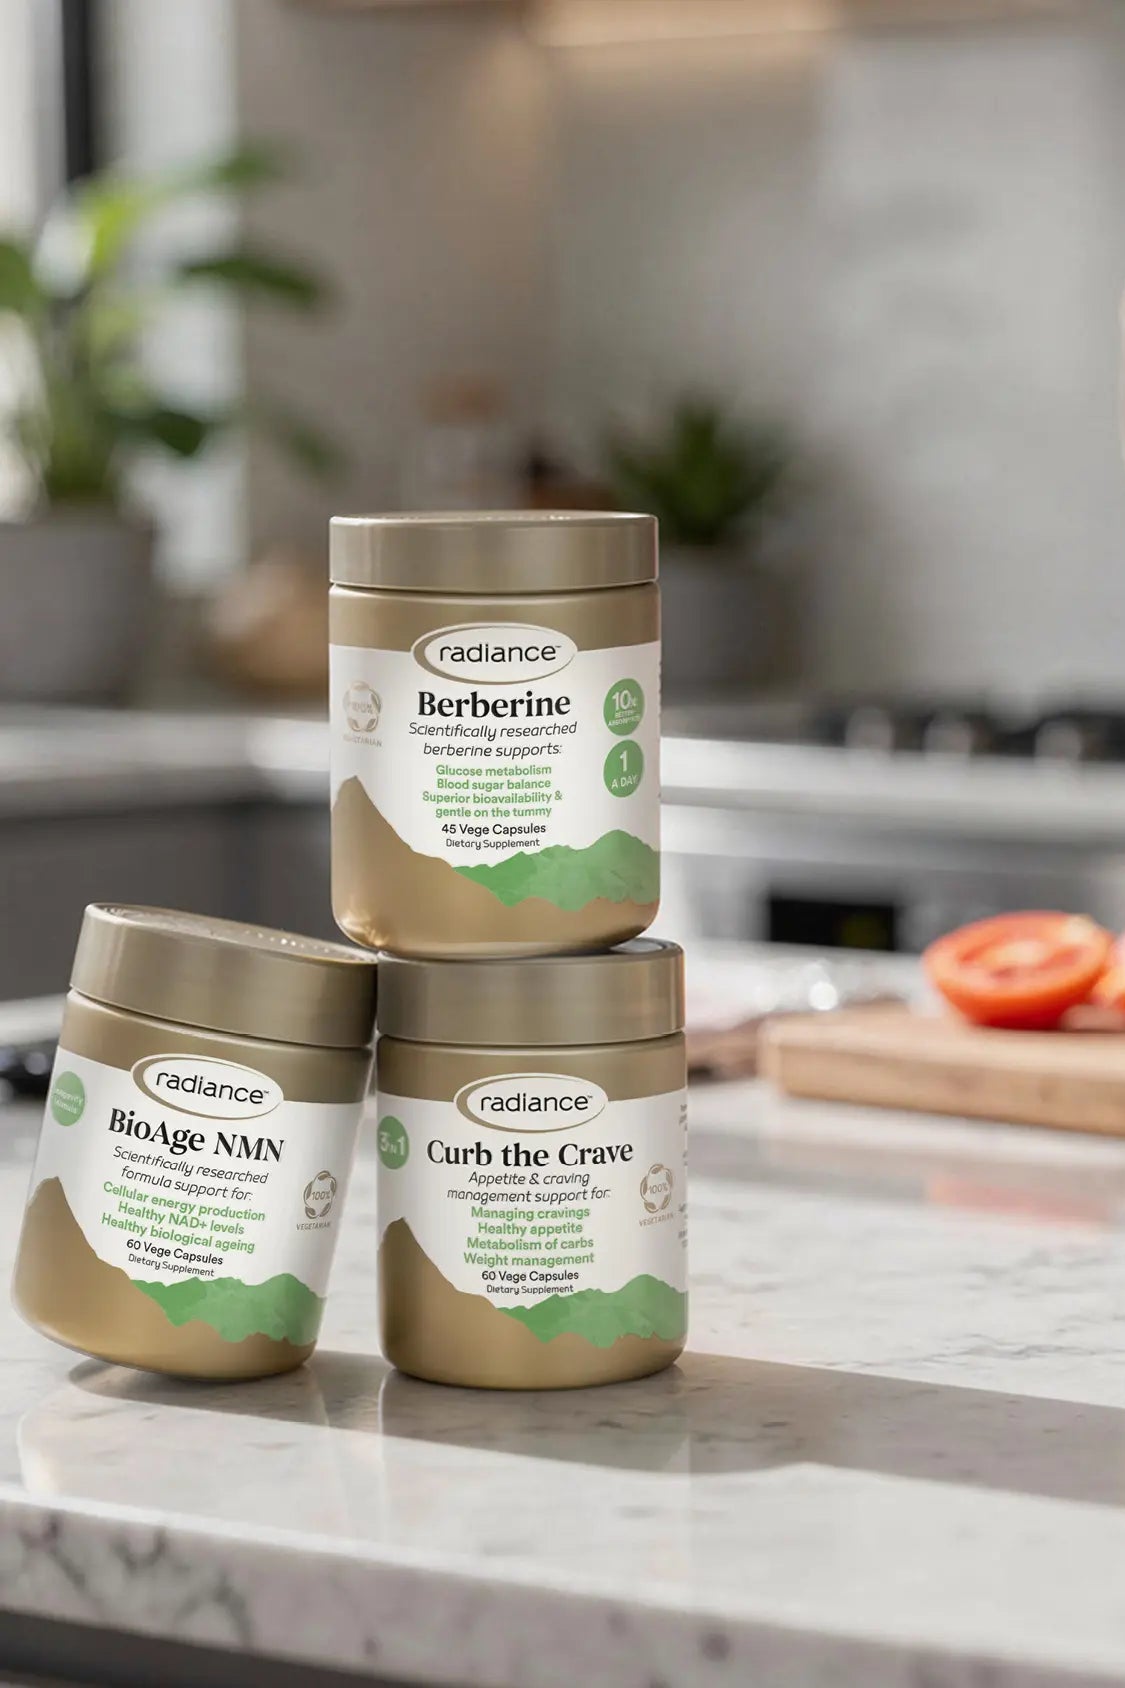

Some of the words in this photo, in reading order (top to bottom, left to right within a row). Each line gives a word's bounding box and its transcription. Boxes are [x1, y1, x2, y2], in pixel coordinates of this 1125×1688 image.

[418, 691, 570, 718] Berberine
[409, 722, 496, 741] Scientifically
[500, 722, 577, 738] researched
[423, 743, 492, 757] berberine
[496, 743, 562, 760] supports:
[620, 750, 628, 772] 1
[436, 765, 482, 776] Glucose
[485, 765, 551, 776] metabolism
[437, 778, 469, 789] Blood
[472, 780, 504, 792] sugar
[507, 778, 551, 789] balance
[612, 779, 618, 789] A
[620, 775, 638, 787] DAY
[422, 791, 470, 805] Superior
[473, 791, 551, 805] bioavailability
[554, 791, 562, 801] &
[436, 807, 471, 818] gentle
[474, 808, 489, 817] on
[492, 807, 510, 817] the
[513, 806, 552, 818] tummy
[441, 824, 456, 834] 45
[459, 824, 489, 838] Vege
[492, 823, 546, 837] Capsules
[446, 838, 481, 851] Dietary
[483, 838, 540, 849] Supplement
[108, 1108, 205, 1155] BioAge
[213, 1132, 284, 1163] NMN
[427, 1140, 492, 1166] Curb
[501, 1143, 549, 1166] the
[559, 1143, 633, 1166] Crave
[113, 1146, 195, 1177] Scientifically
[196, 1164, 268, 1184] researched
[121, 1167, 171, 1191] formula
[174, 1184, 227, 1200] support
[231, 1188, 253, 1201] for:
[469, 1172, 525, 1187] Appetite
[529, 1173, 539, 1184] &
[543, 1172, 589, 1187] craving
[103, 1181, 149, 1203] Cellular
[151, 1196, 196, 1216] energy
[199, 1205, 265, 1221] production
[312, 1190, 330, 1200] 100%
[447, 1189, 531, 1205] management
[535, 1189, 587, 1205] support
[118, 1201, 166, 1226] Healthy
[168, 1213, 208, 1230] NAD+
[210, 1220, 244, 1235] levels
[471, 1207, 534, 1222] Managing
[537, 1207, 590, 1220] cravings
[102, 1213, 148, 1237] Healthy
[150, 1225, 212, 1248] biological
[215, 1238, 255, 1254] ageing
[478, 1222, 526, 1237] Healthy
[530, 1223, 583, 1236] appetite
[467, 1238, 541, 1250] Metabolism
[545, 1238, 558, 1249] of
[561, 1237, 593, 1248] carbs
[126, 1239, 141, 1251] 60
[144, 1242, 171, 1259] Vege
[173, 1249, 224, 1265] Capsules
[464, 1252, 508, 1267] Weight
[512, 1252, 594, 1268] management
[128, 1253, 160, 1270] Dietary
[162, 1261, 214, 1277] Supplement
[481, 1271, 496, 1281] 60
[499, 1271, 527, 1285] Vege
[529, 1270, 579, 1284] Capsules
[486, 1284, 519, 1295] Dietary
[521, 1284, 574, 1294] Supplement
